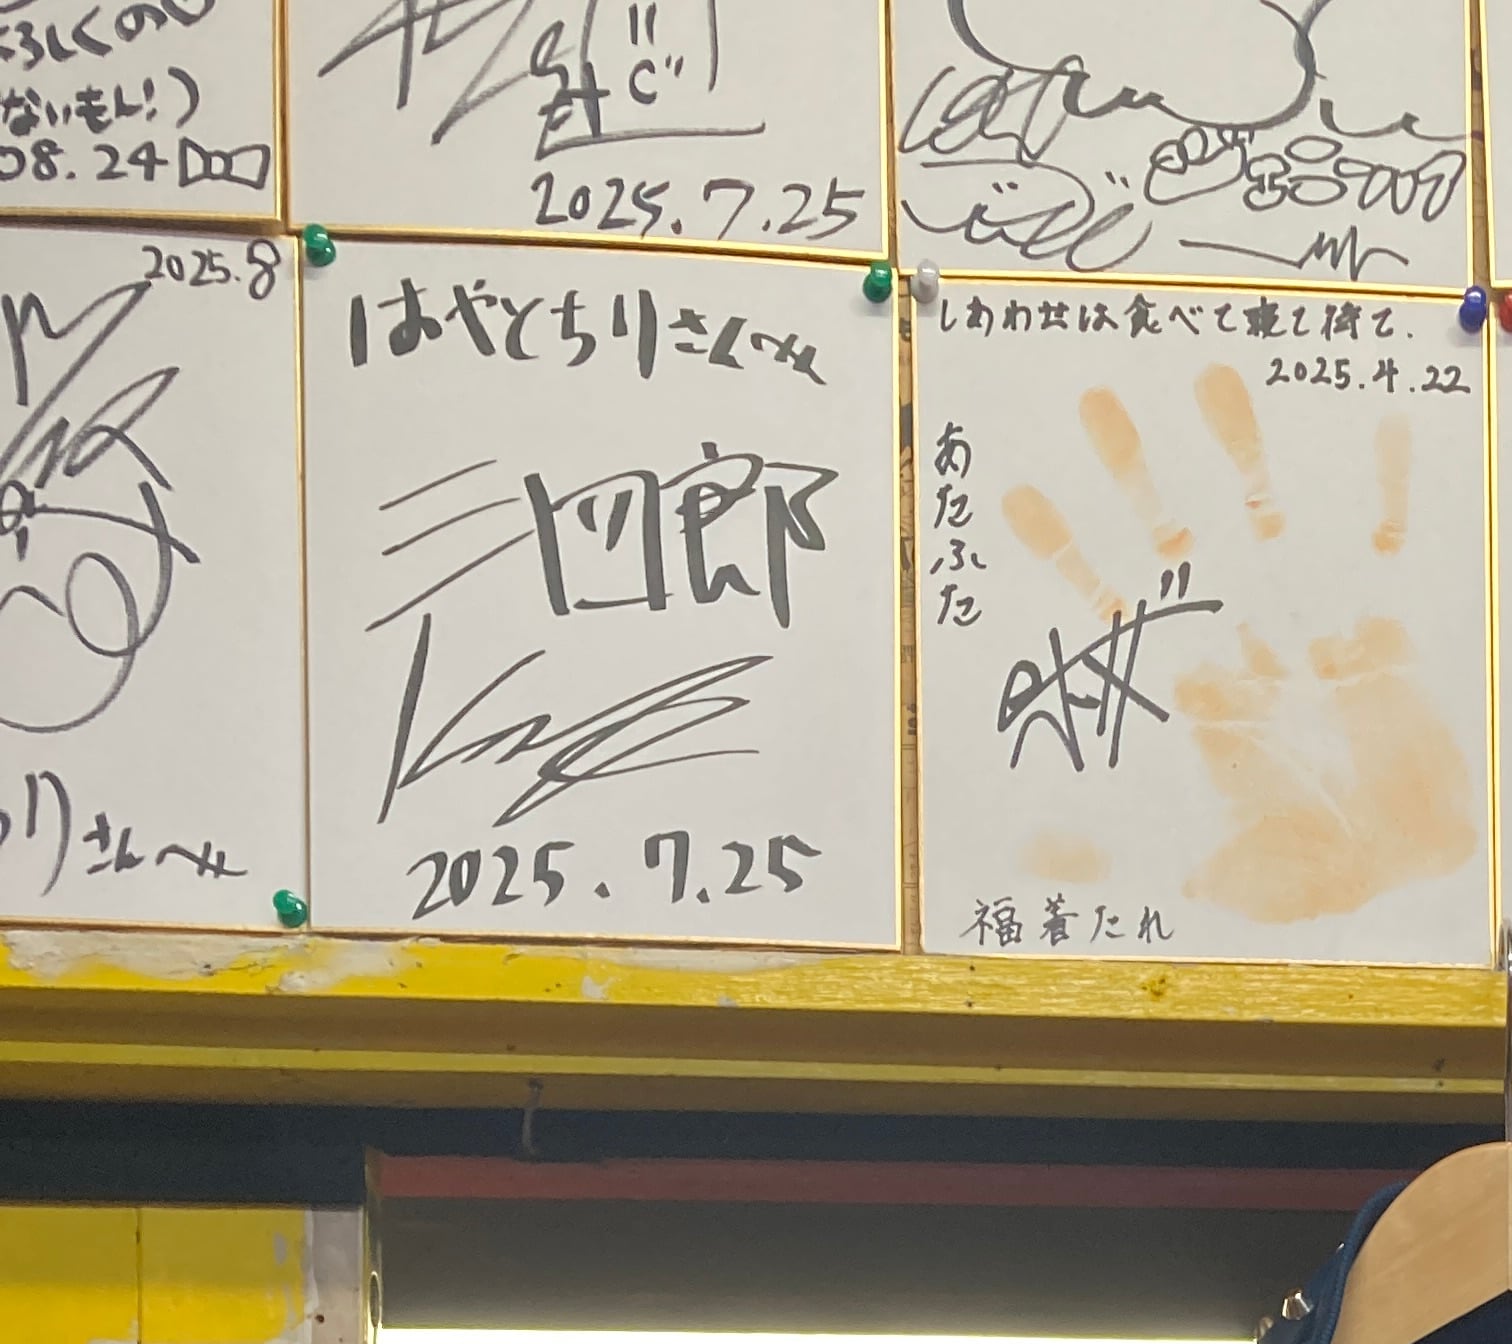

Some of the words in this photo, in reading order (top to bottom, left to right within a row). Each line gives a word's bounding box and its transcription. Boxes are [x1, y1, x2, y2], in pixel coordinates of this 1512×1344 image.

[142, 239, 281, 300] 2025.8
[1265, 355, 1471, 393] 2025.4.22
[930, 421, 988, 628] あたふた
